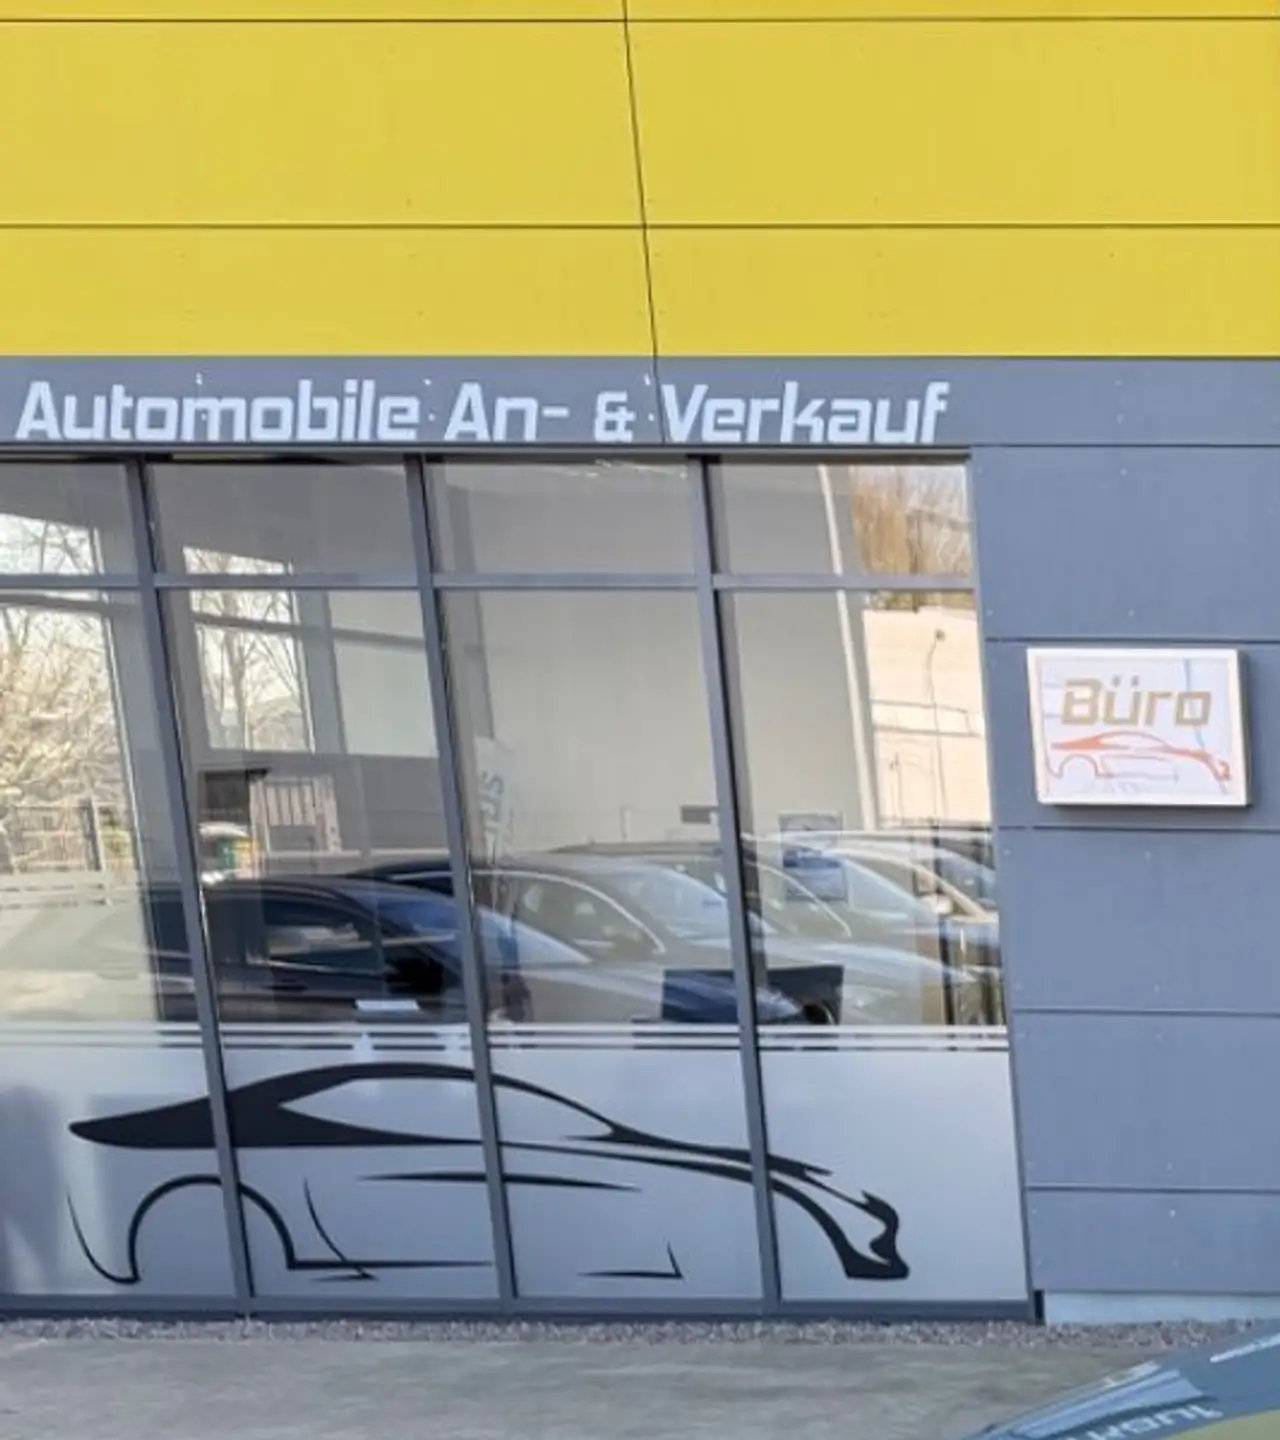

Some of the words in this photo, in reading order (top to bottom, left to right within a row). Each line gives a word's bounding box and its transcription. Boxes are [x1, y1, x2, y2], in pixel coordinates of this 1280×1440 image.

[15, 379, 420, 441] Automobile
[443, 382, 569, 442] An-
[594, 391, 636, 442] &
[661, 381, 950, 443] Verkauf
[1060, 675, 1212, 726] Büro
